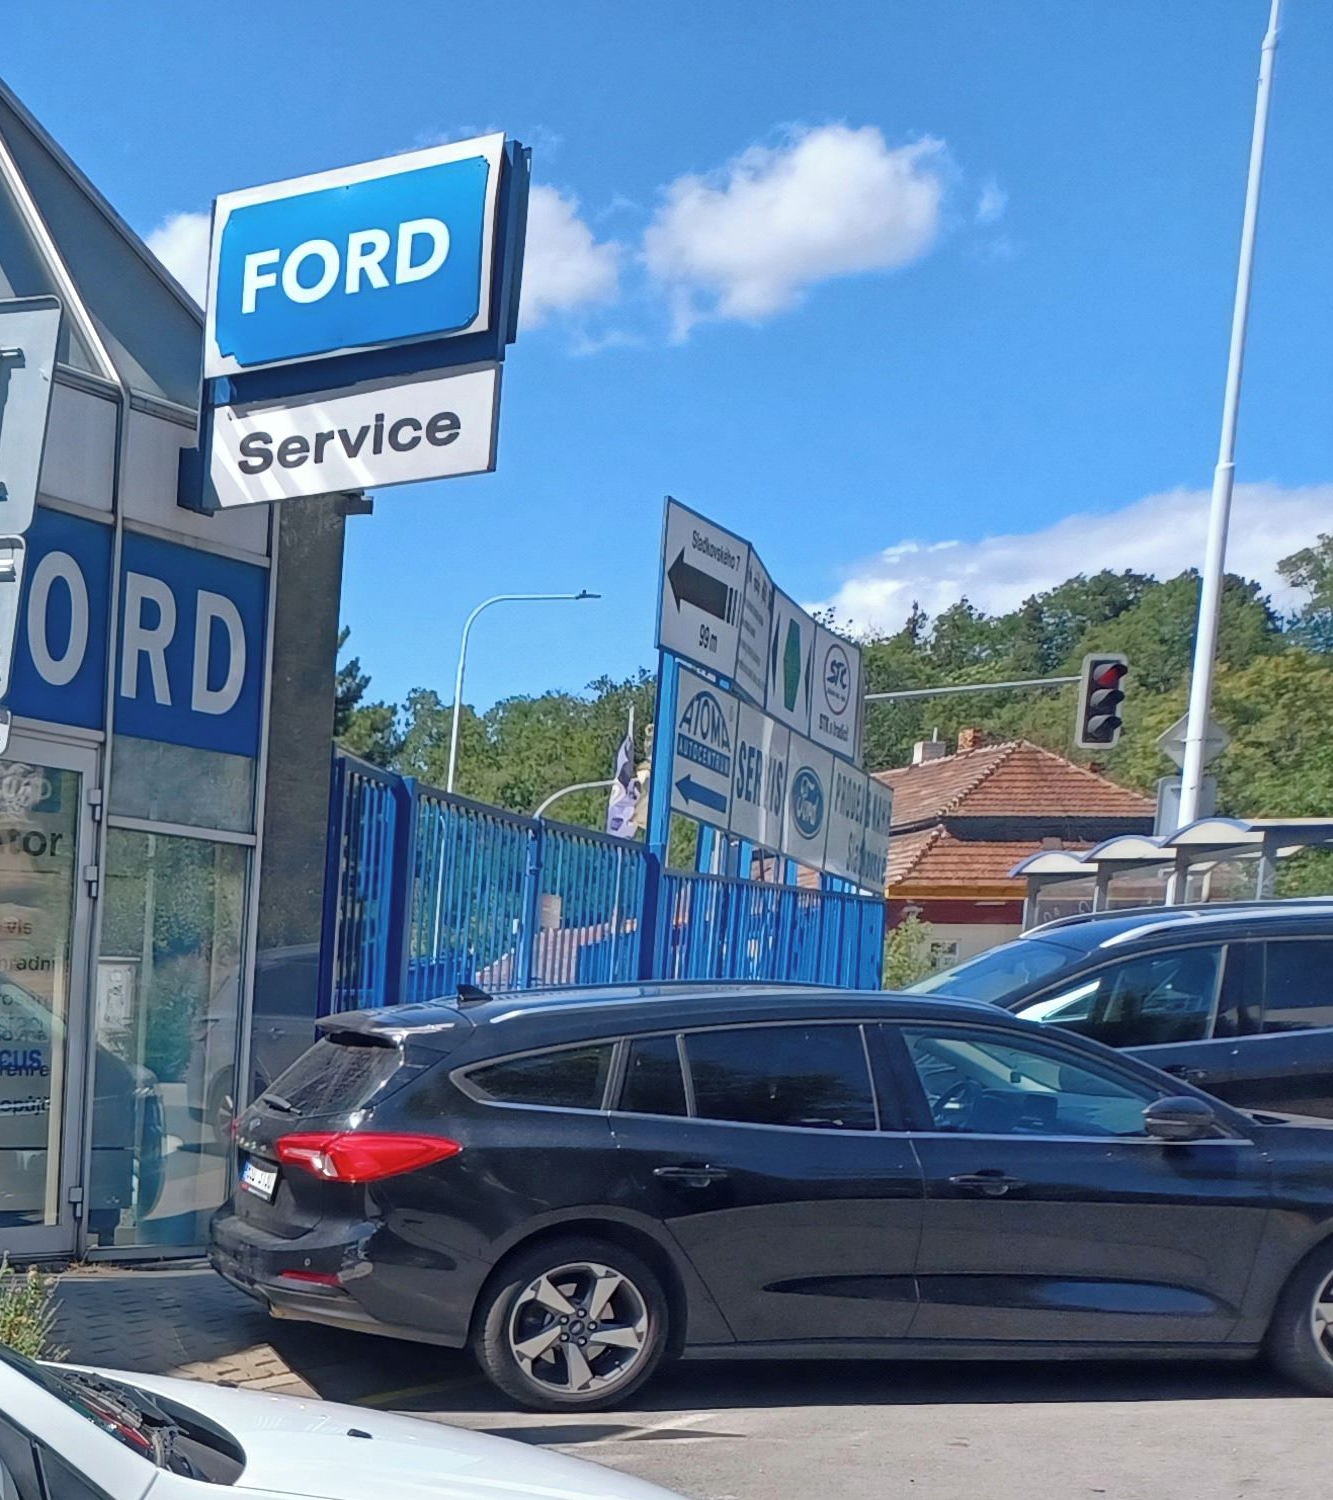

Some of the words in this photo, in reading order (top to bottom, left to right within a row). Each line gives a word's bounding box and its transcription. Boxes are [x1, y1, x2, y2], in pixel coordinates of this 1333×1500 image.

[240, 217, 450, 314] FORD
[237, 411, 462, 476] Service
[25, 549, 247, 715] ORD
[698, 623, 710, 649] 99
[736, 741, 784, 817] SERVIS
